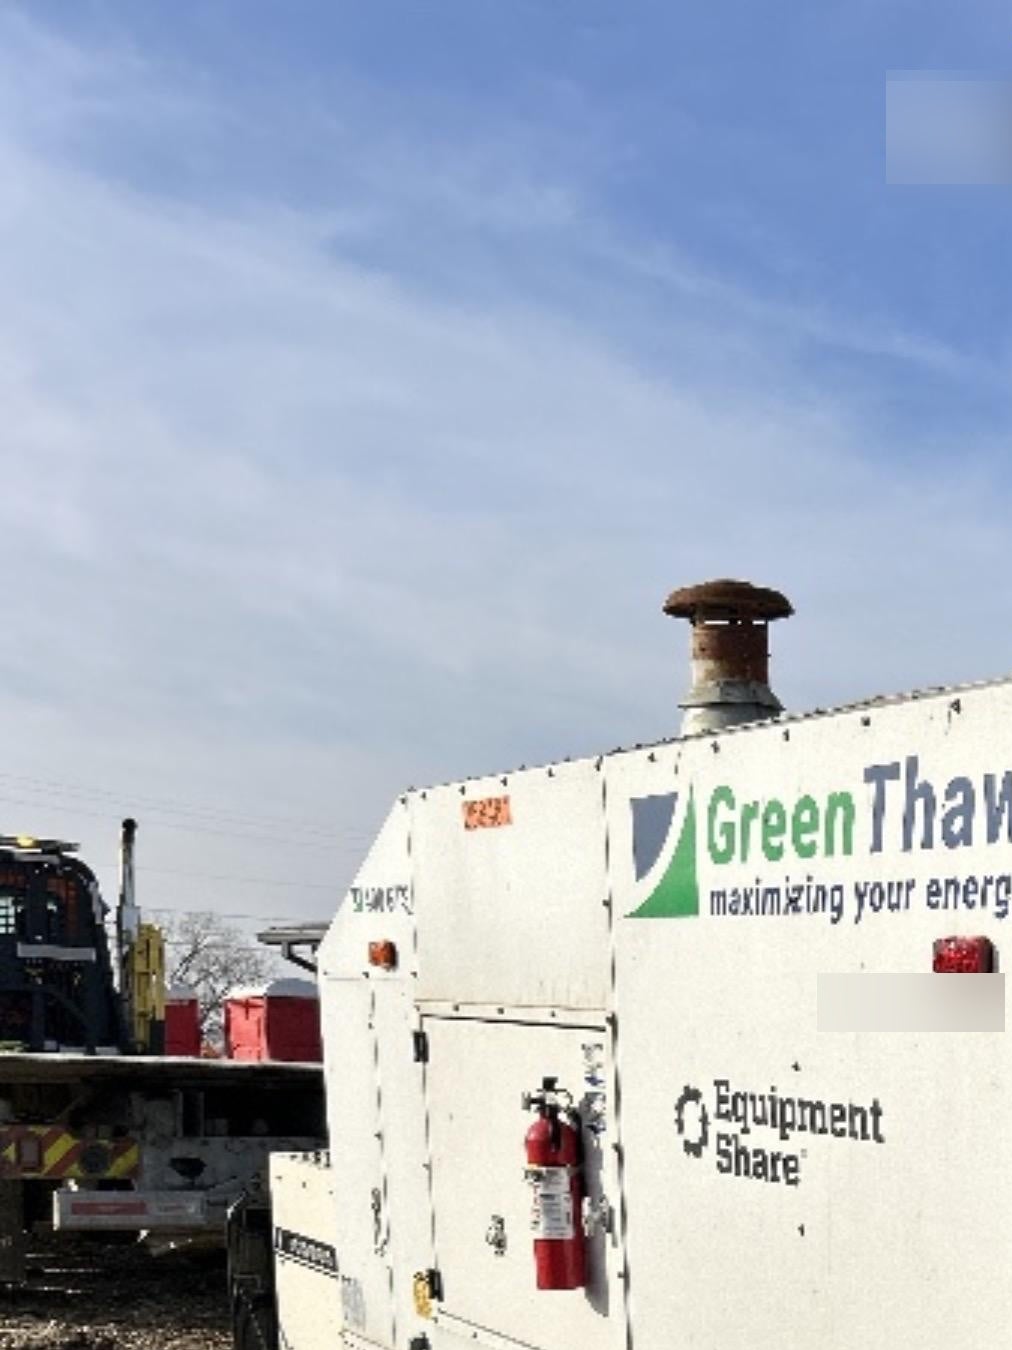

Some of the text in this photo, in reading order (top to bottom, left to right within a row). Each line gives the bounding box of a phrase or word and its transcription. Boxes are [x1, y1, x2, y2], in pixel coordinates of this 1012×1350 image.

[709, 875, 844, 925] maximizing
[853, 876, 916, 925] your
[713, 1079, 885, 1144] Equipment
[716, 1132, 801, 1187] Share
